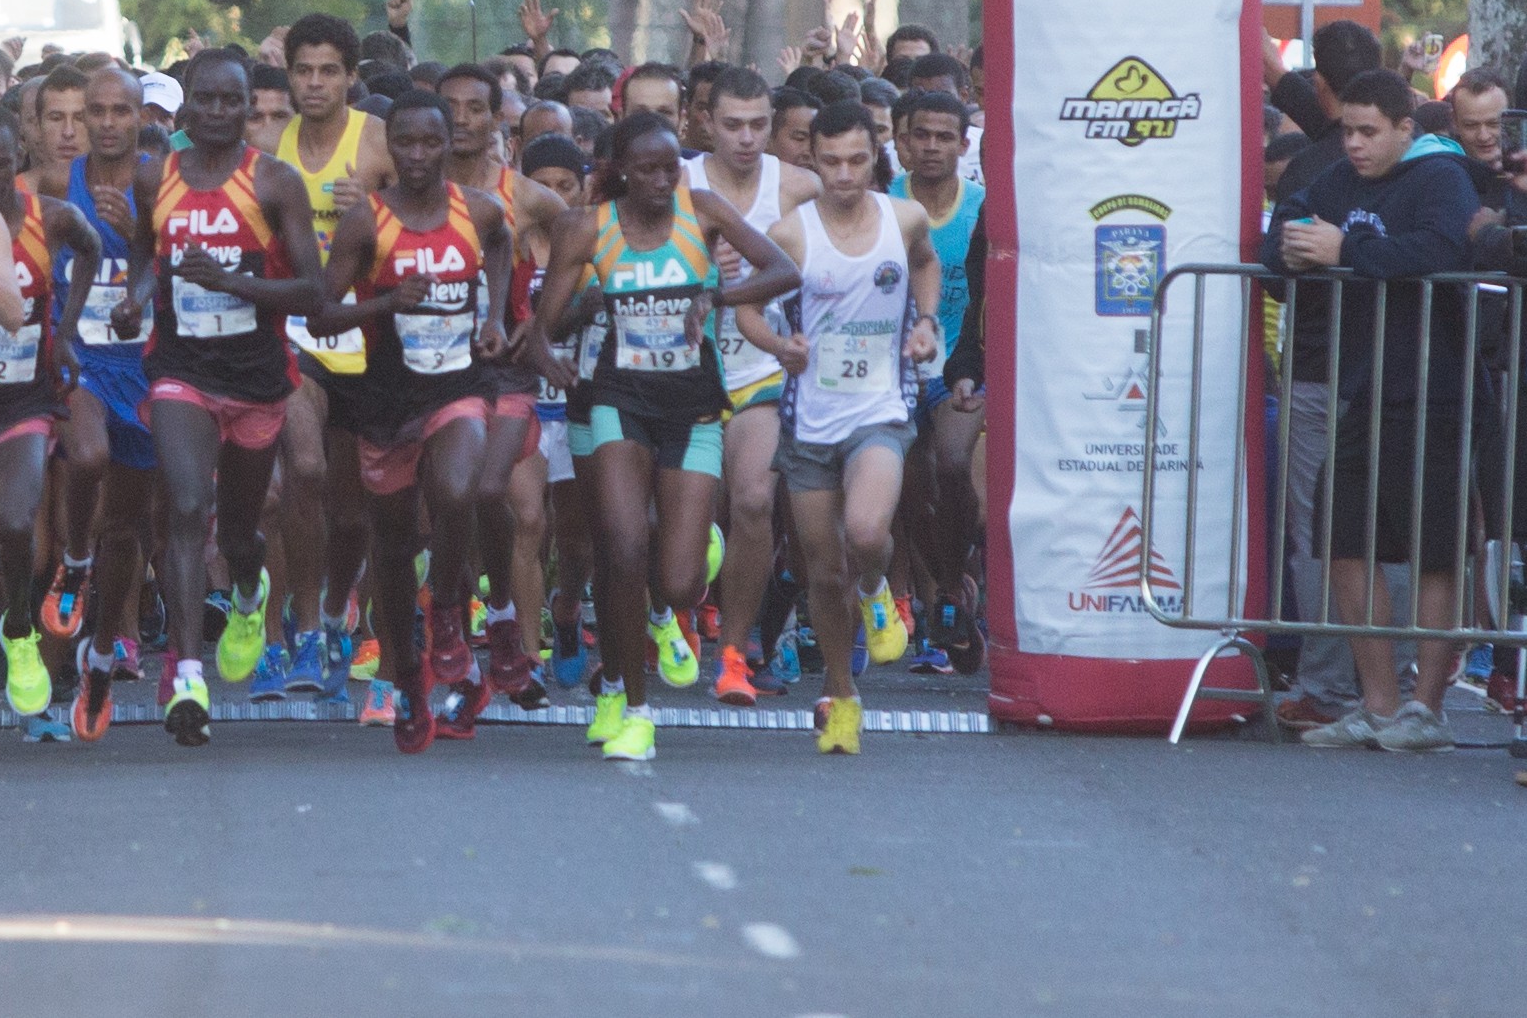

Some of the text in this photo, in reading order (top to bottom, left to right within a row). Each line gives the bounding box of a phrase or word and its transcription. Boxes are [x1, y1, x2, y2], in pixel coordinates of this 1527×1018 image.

[1087, 119, 1176, 138] FM 97.1
[168, 207, 240, 236] FILA
[394, 244, 467, 276] FILA
[613, 258, 689, 290] FILA
[213, 314, 223, 333] 1
[720, 338, 745, 356] 27
[650, 350, 676, 368] 19
[841, 359, 869, 378] 28
[1085, 443, 1179, 456] UNIVERSIADE
[1058, 459, 1122, 472] ESTADUAL
[1127, 459, 1145, 472] DE
